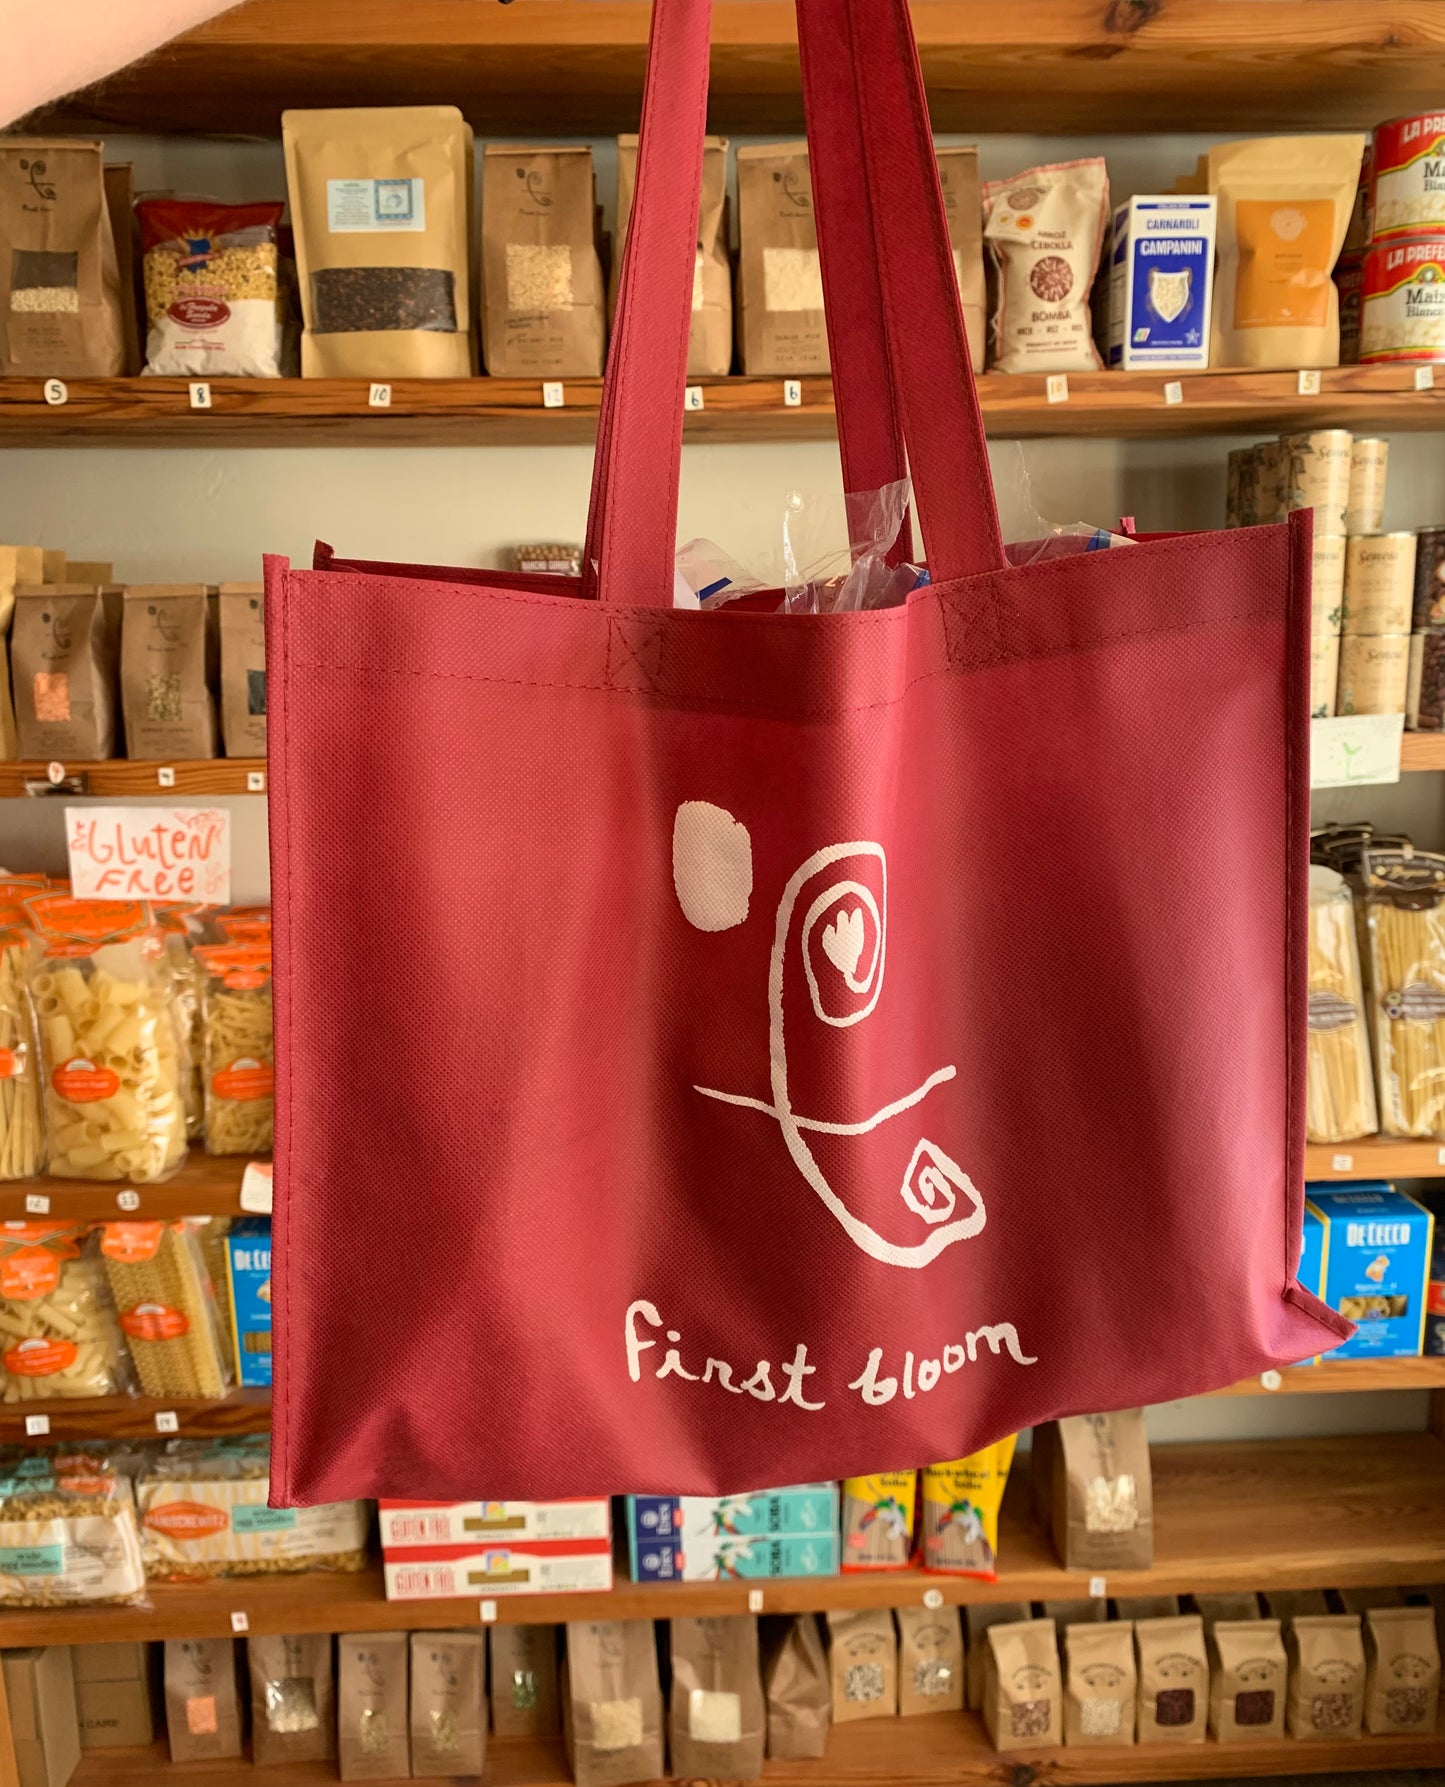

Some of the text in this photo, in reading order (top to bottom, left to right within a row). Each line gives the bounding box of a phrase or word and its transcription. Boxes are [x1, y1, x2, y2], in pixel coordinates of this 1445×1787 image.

[1403, 120, 1420, 144] LA
[1147, 218, 1200, 231] CARNAROLI
[1141, 239, 1203, 256] CAMPANINI
[1387, 248, 1405, 271] LA
[1032, 310, 1072, 322] BOMBA
[1303, 373, 1315, 390] 5
[50, 384, 62, 401] 5
[197, 386, 206, 404] 8
[373, 387, 388, 402] 10
[691, 391, 700, 407] 6
[790, 385, 798, 400] 6
[625, 1299, 1039, 1411] first bloom
